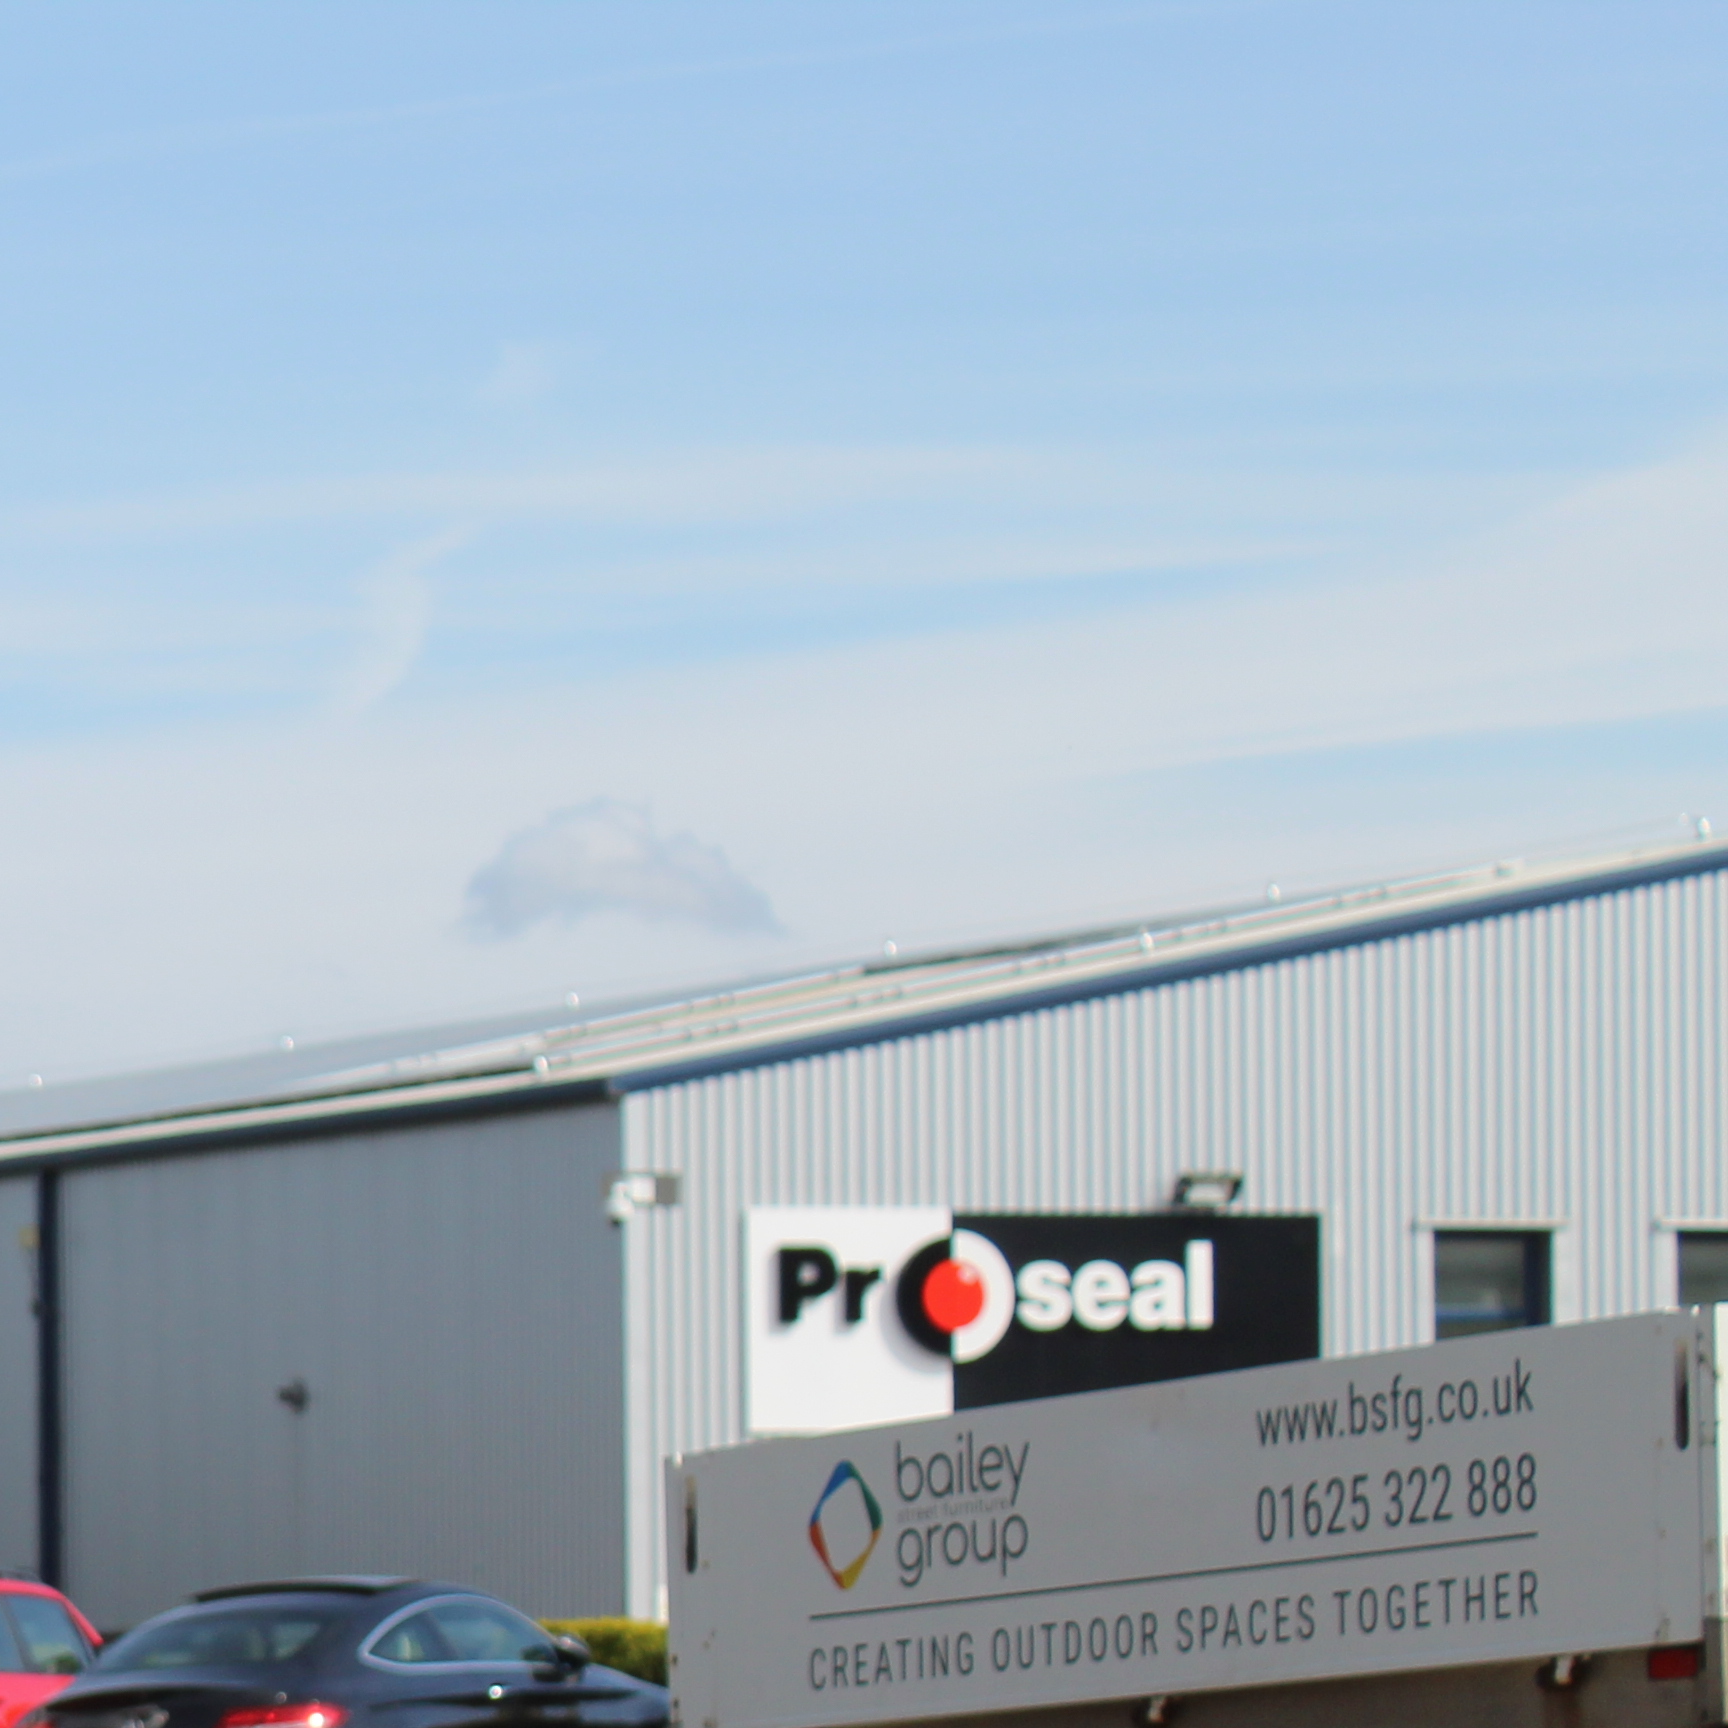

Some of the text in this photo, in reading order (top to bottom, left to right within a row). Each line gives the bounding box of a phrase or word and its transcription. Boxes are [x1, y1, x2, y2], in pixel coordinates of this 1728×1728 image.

[1255, 1358, 1535, 1447] www.bsfg.co.uk
[894, 1429, 1030, 1506] bailey
[942, 1496, 1009, 1516] furniture
[1255, 1452, 1539, 1544] 01625 322 888
[895, 1512, 1029, 1588] group
[808, 1568, 1540, 1692] CREATING OUTDOOR SPACES TOGETHER
